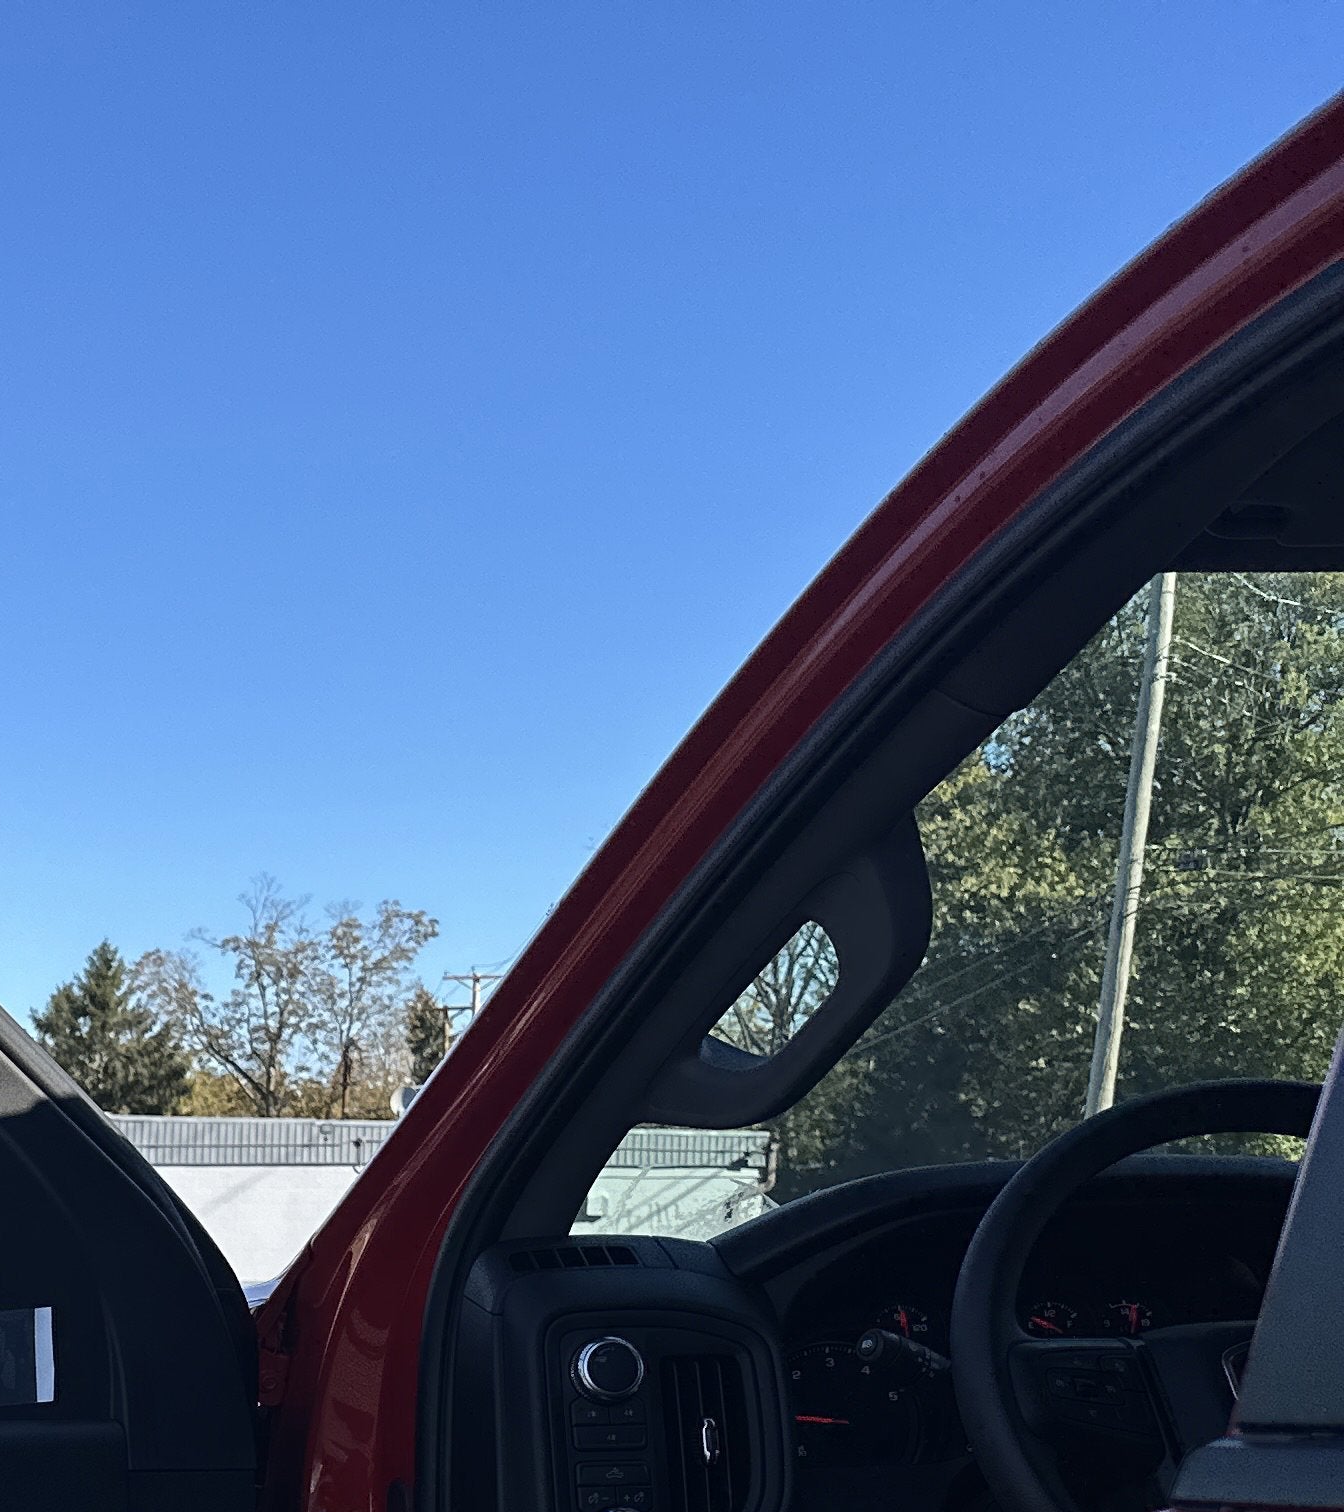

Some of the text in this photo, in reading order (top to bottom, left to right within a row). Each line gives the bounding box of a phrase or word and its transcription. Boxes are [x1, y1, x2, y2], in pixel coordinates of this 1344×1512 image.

[825, 1357, 835, 1367] 3
[792, 1370, 801, 1380] 2
[861, 1365, 872, 1375] 4
[888, 1391, 899, 1401] 5
